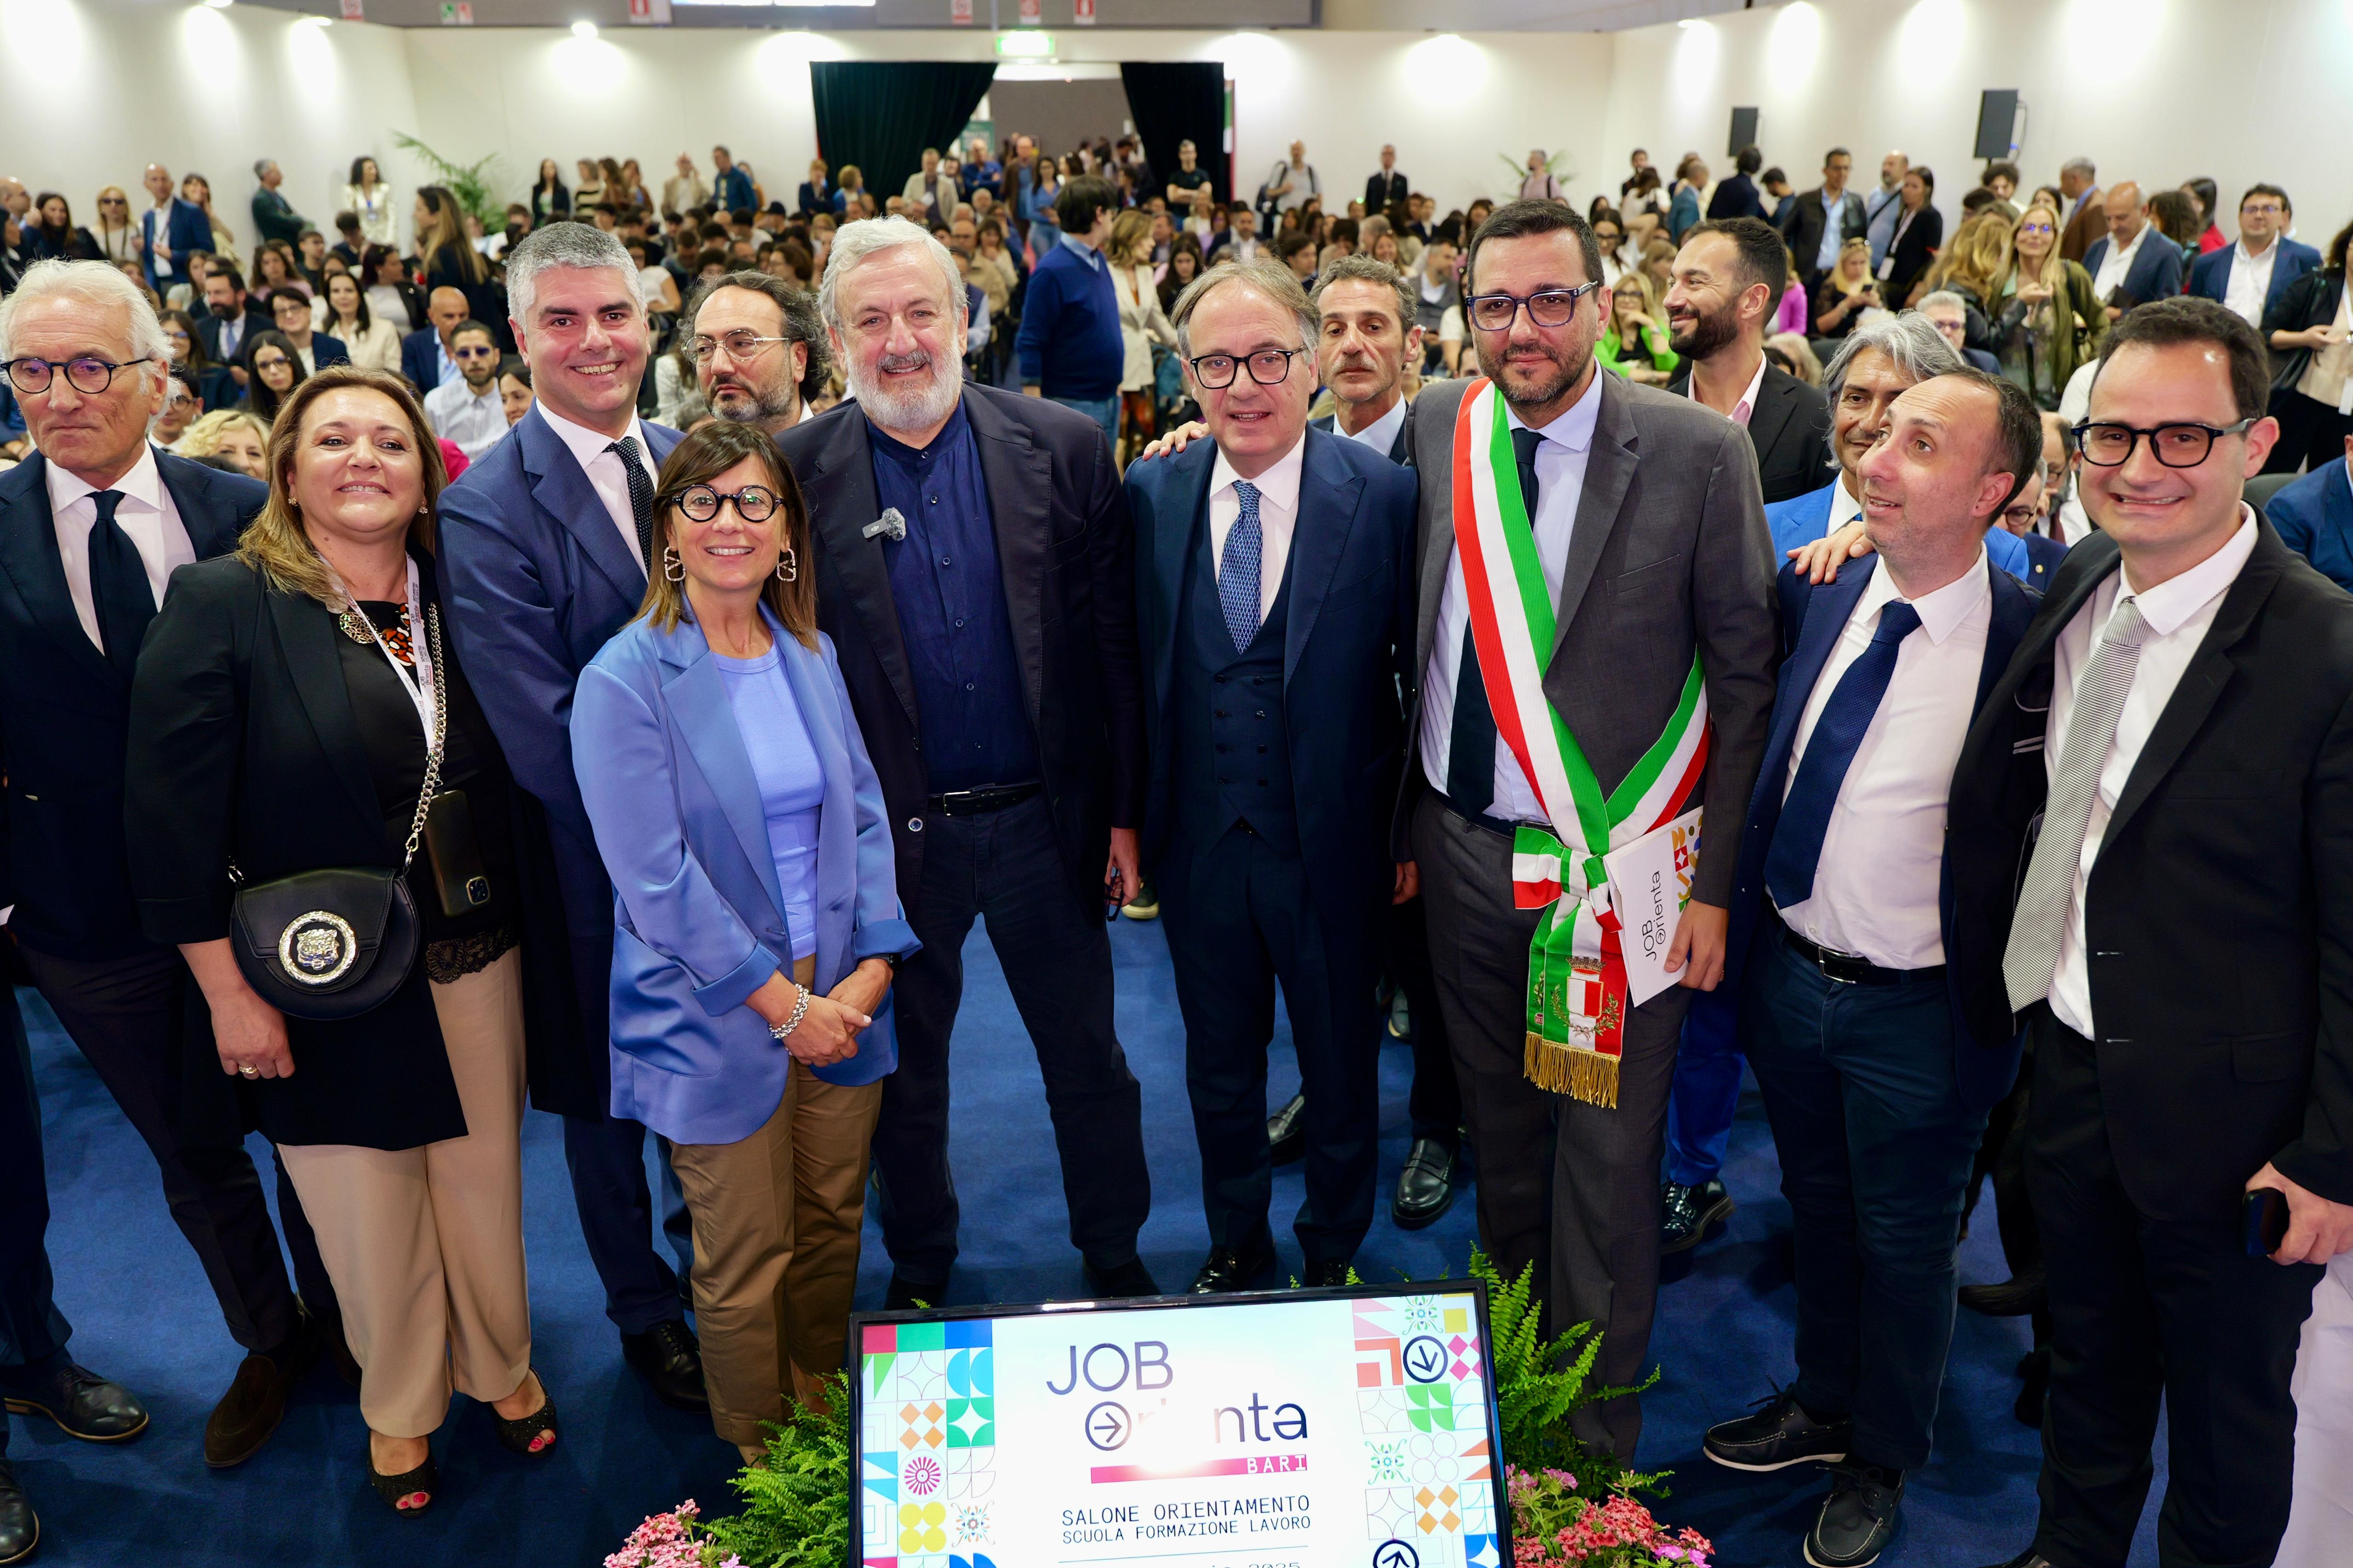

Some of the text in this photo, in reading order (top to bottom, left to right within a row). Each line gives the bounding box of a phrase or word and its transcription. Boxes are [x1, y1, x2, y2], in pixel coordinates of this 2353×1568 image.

[1642, 920, 1657, 961] JOB
[1046, 1341, 1173, 1395] JOB
[1246, 1454, 1307, 1474] BARI
[1062, 1495, 1310, 1526] SALONE ORIENTAMENTO
[1063, 1516, 1311, 1544] SCUOLA FORMAZIONE LAVORO
